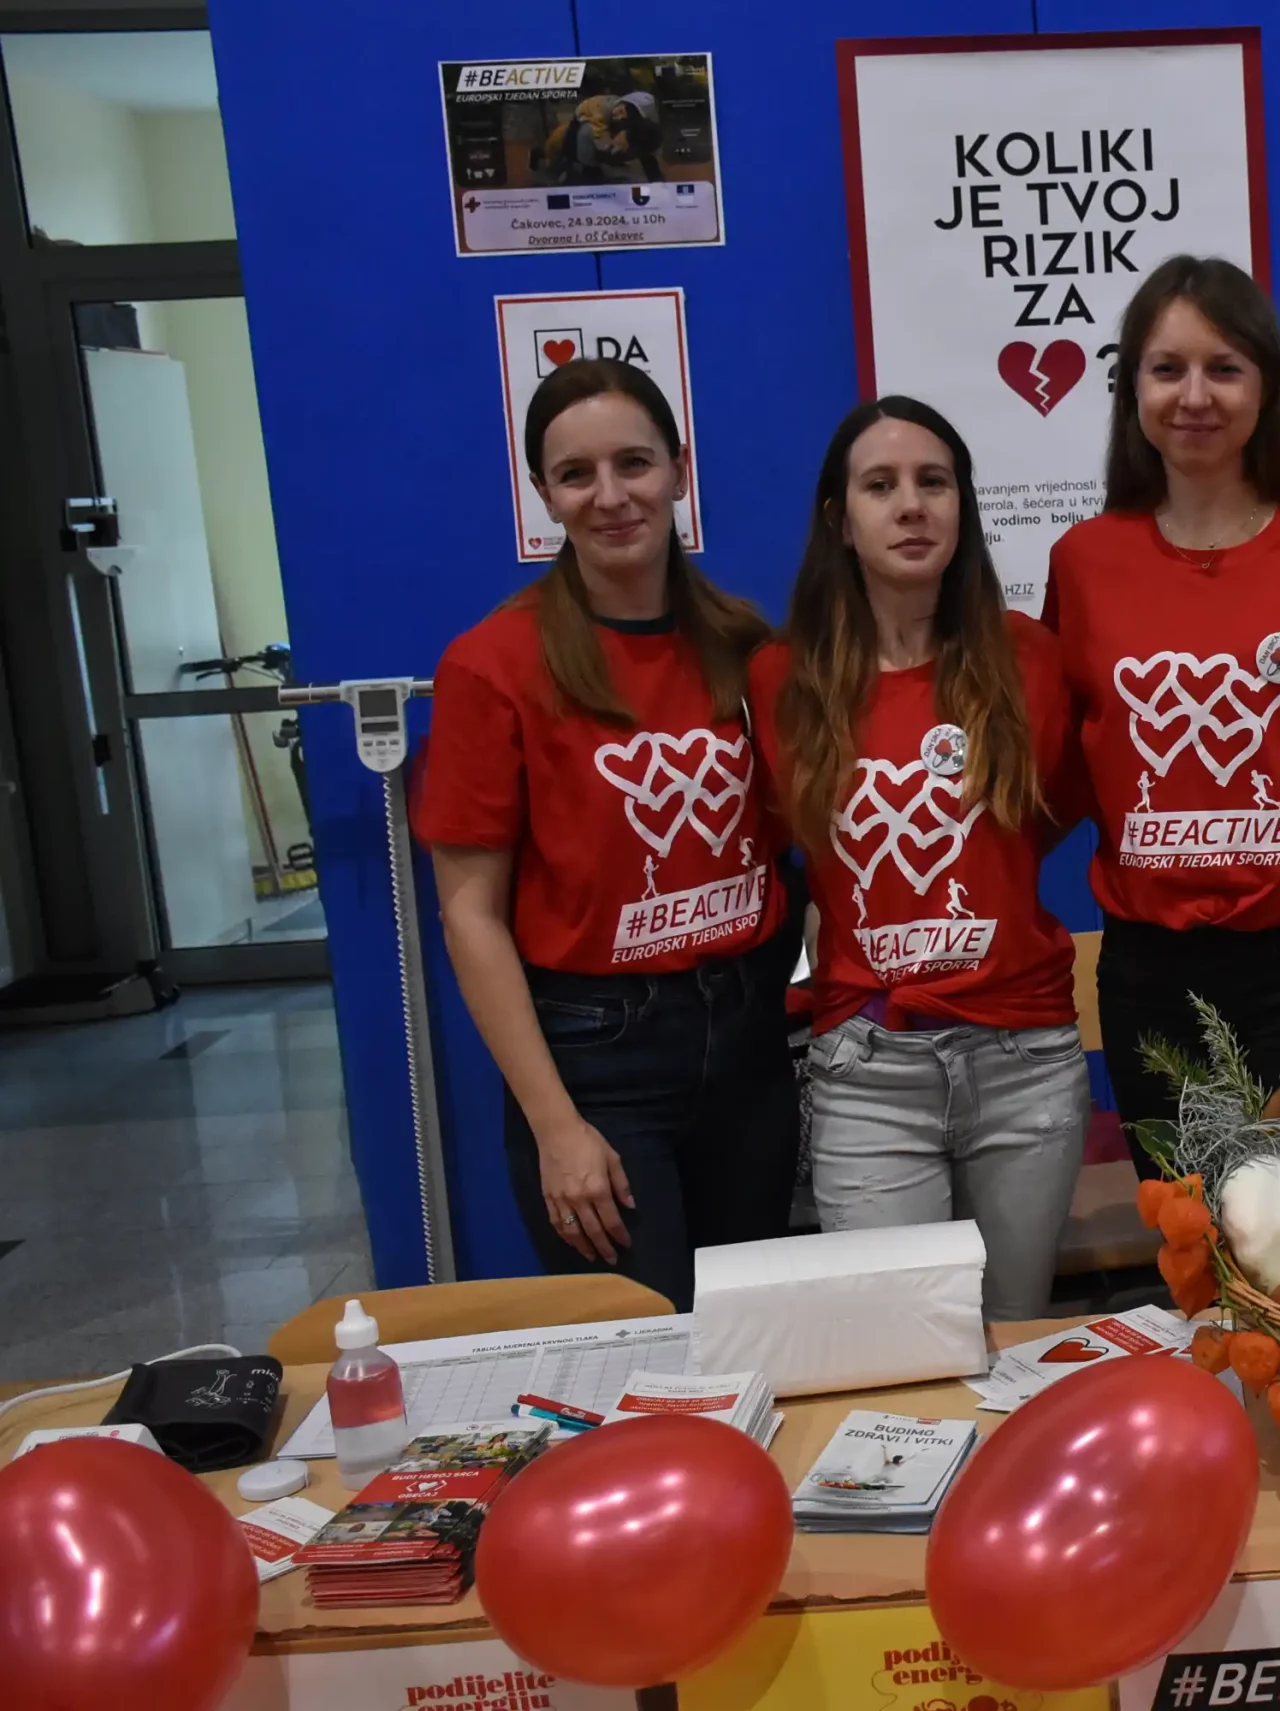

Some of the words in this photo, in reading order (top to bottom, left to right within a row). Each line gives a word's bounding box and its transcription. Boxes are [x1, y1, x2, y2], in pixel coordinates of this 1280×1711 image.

[464, 65, 580, 88] #BEACTIVE
[456, 92, 502, 103] EUROPSKI
[504, 91, 540, 101] TJEDAN
[541, 89, 578, 100] SPORTA
[954, 128, 1154, 178] KOLIKI
[934, 185, 1003, 230] JE
[1026, 178, 1181, 226] TVOJ
[510, 217, 566, 230] Čakovec,
[631, 215, 641, 225] u
[643, 213, 667, 224] 10h
[528, 234, 573, 246] Dvorana
[585, 231, 599, 243] OŠ
[602, 230, 645, 242] Čakovec
[982, 230, 1140, 278] RIZIK
[1013, 283, 1096, 328] ZA
[596, 335, 650, 363] DA
[1034, 480, 1097, 496] vrijednosti
[979, 500, 1018, 512] terola,
[1022, 497, 1064, 510] šećera
[1069, 499, 1077, 507] u
[992, 514, 1041, 527] vodimo
[1051, 512, 1084, 526] bolju
[1005, 583, 1035, 596] HZJZ
[1178, 853, 1235, 868] TJEDAN
[611, 935, 687, 964] EUROPSKI
[691, 923, 734, 946] TJEDAN
[735, 912, 762, 932] SPO
[922, 960, 981, 974] SPORTA
[472, 1344, 502, 1354] TABLICA
[503, 1340, 541, 1350] MJERENJA
[542, 1337, 574, 1347] KRVNOG
[575, 1335, 599, 1343] TLAKA
[844, 1429, 901, 1443] ZDRAVI
[904, 1436, 910, 1444] I
[915, 1437, 955, 1446] VITKI
[873, 1423, 936, 1437] BUDIMO
[418, 1472, 452, 1480] HEROJ
[884, 1641, 961, 1671] podi
[892, 1666, 983, 1686] energ
[405, 1671, 557, 1706] podijelite
